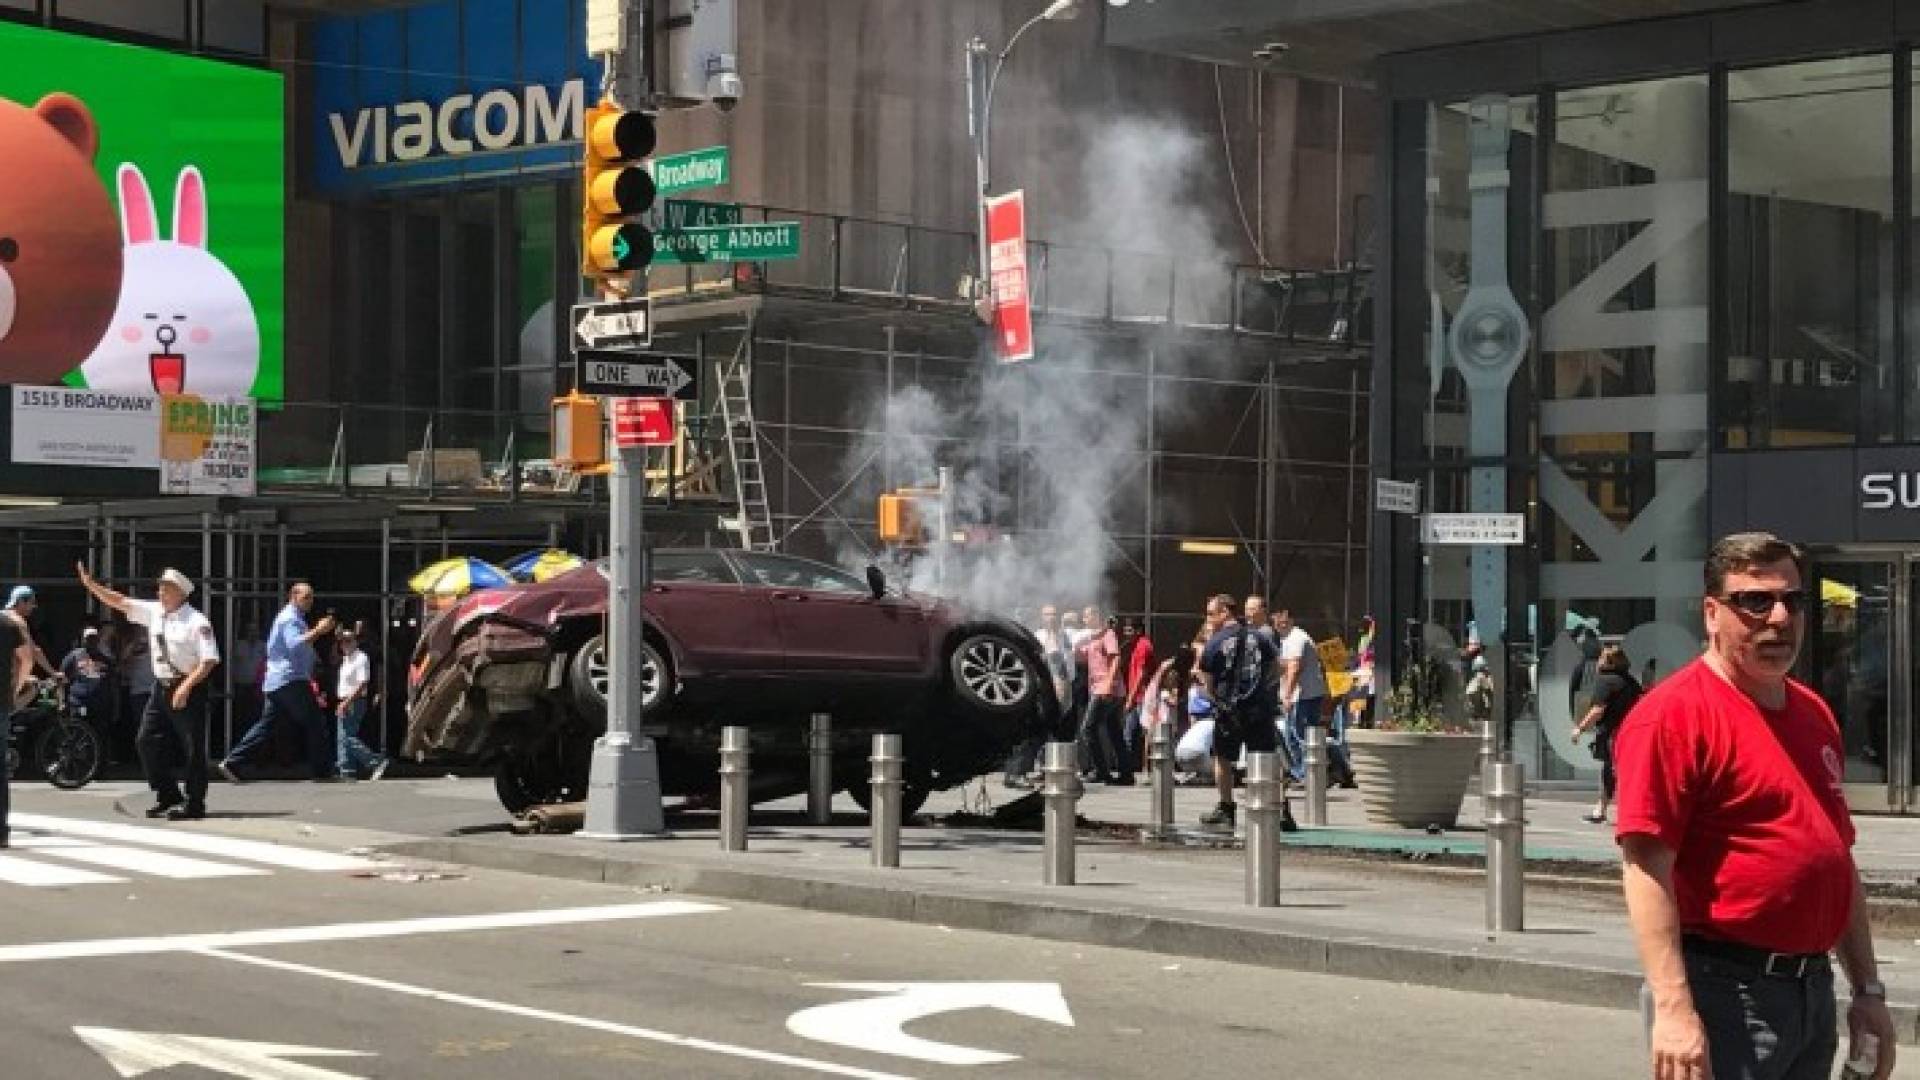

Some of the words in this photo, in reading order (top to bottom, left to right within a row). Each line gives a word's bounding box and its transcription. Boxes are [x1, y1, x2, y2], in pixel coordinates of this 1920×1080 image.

[658, 157, 723, 188] Broadway
[669, 203, 687, 227] W
[696, 206, 717, 227] 45
[652, 232, 719, 255] George
[728, 226, 790, 249] Abbott
[595, 363, 630, 383] ONE
[645, 367, 681, 387] WAY
[20, 390, 60, 409] 1515
[64, 393, 153, 412] BROADWAY
[168, 401, 250, 425] SPRING
